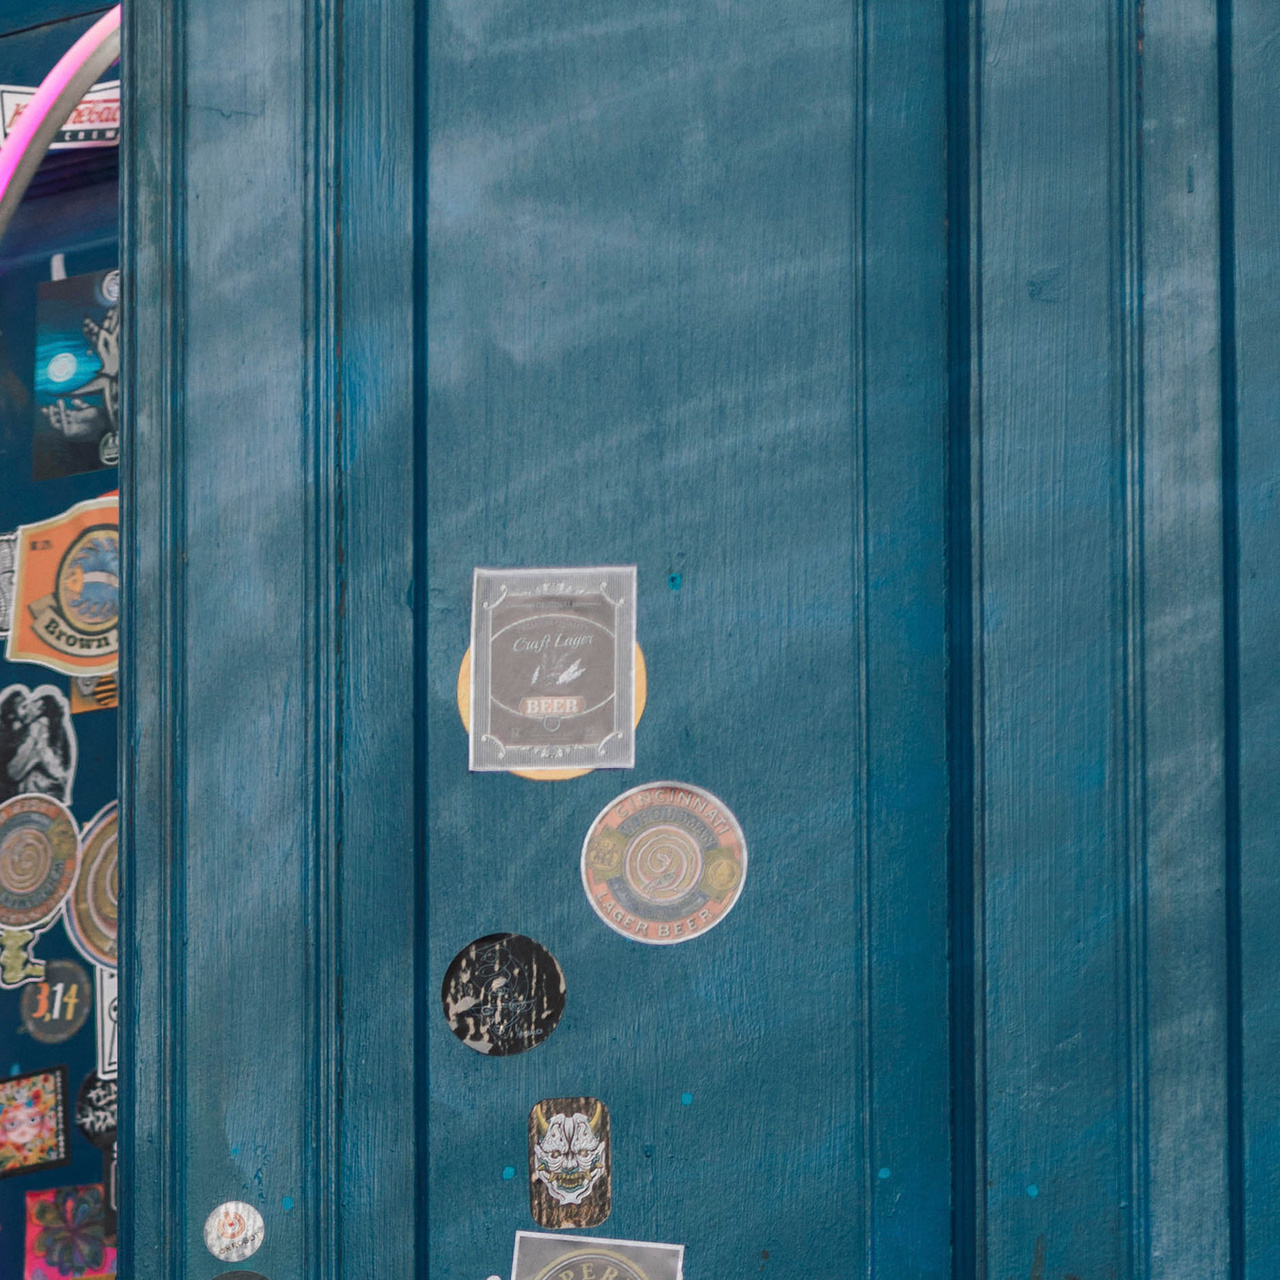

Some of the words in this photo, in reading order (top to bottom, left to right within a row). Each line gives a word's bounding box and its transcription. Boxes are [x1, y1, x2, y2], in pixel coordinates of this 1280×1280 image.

[44, 617, 111, 649] Brown
[513, 634, 551, 653] Craft
[554, 633, 594, 649] Lager
[527, 699, 579, 715] BEER
[615, 789, 731, 835] CINCINNATI
[596, 892, 649, 935] LAGER
[658, 909, 713, 937] BEER
[32, 983, 79, 1022] 3,14
